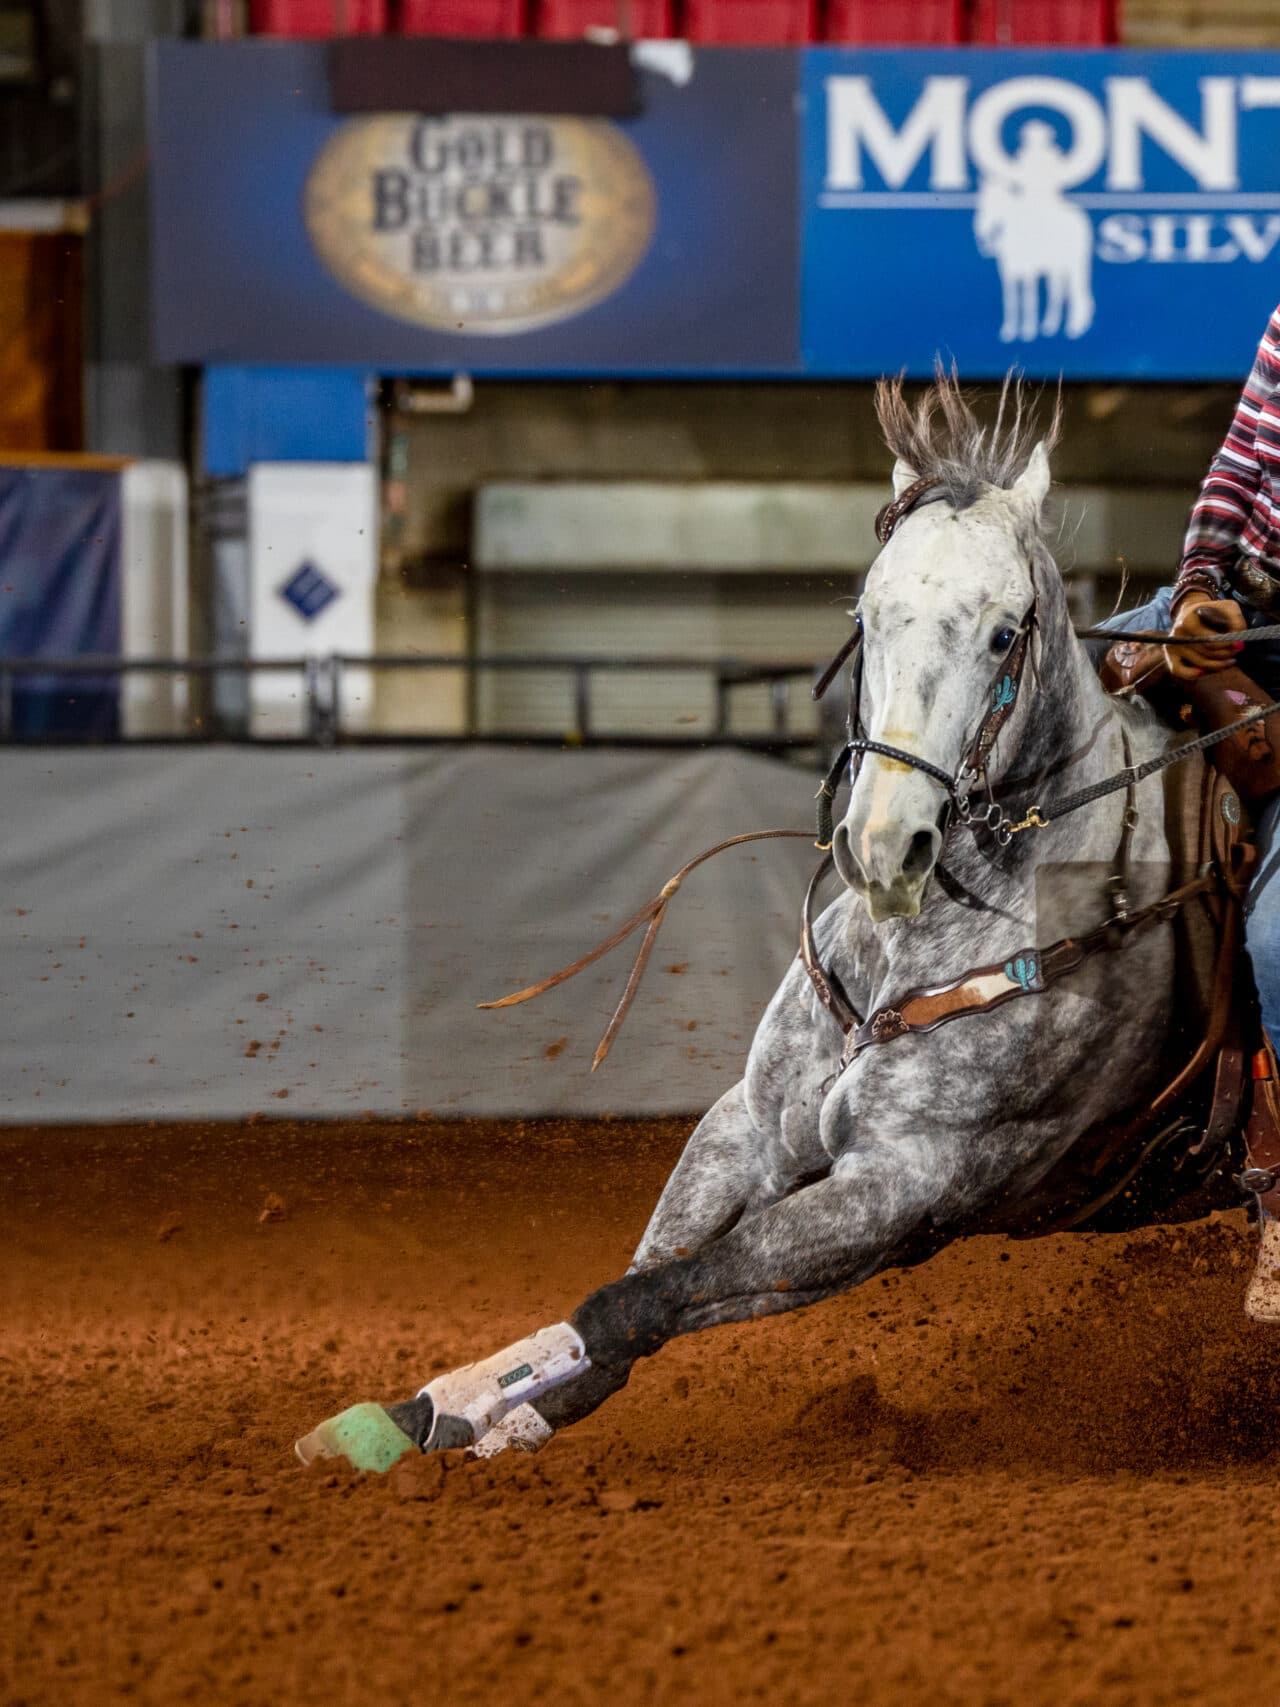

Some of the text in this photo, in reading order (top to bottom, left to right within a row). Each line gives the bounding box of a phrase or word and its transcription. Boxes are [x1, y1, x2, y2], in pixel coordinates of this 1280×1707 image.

[411, 116, 554, 174] GOLD
[372, 168, 582, 231] BUCKLE
[412, 230, 546, 270] BEER
